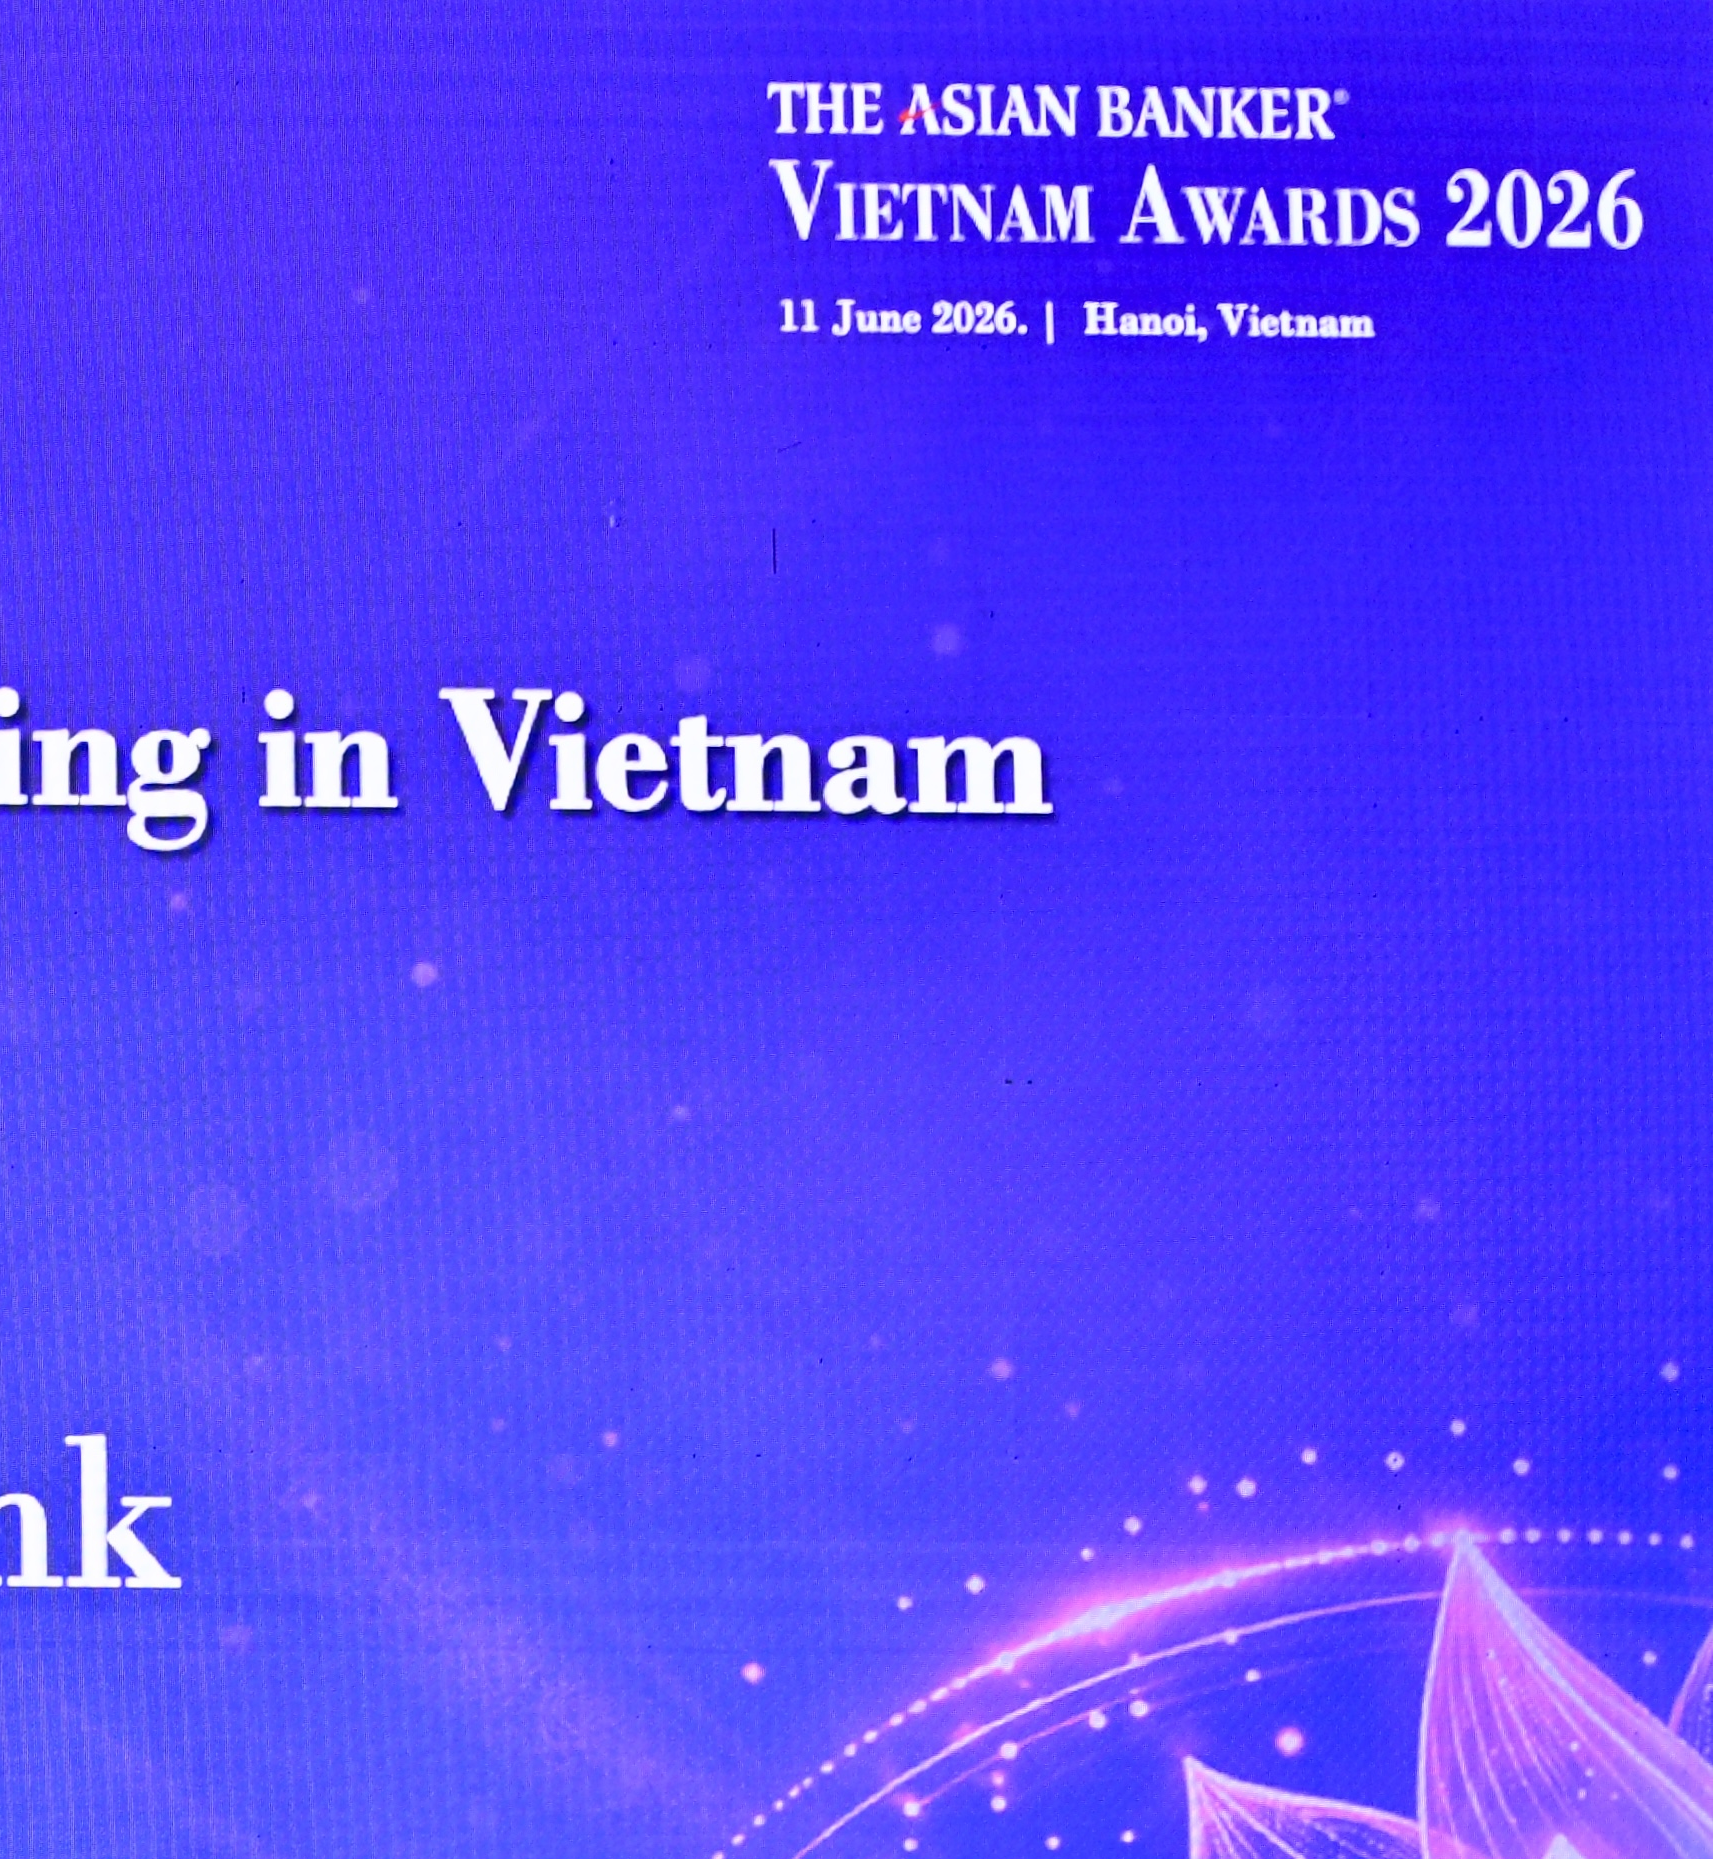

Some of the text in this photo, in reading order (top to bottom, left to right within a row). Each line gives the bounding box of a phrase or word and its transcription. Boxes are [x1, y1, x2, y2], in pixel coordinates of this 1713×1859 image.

[766, 82, 884, 135] THE
[898, 83, 1080, 137] ASIAN
[1445, 167, 1644, 251] 2026
[780, 298, 819, 333] 11
[831, 297, 922, 336] June
[931, 300, 1029, 335] 2026.
[1083, 301, 1208, 343] Hanoi,
[1216, 302, 1376, 339] Vietnam
[257, 688, 400, 809] in
[437, 686, 1054, 816] Vietnam
